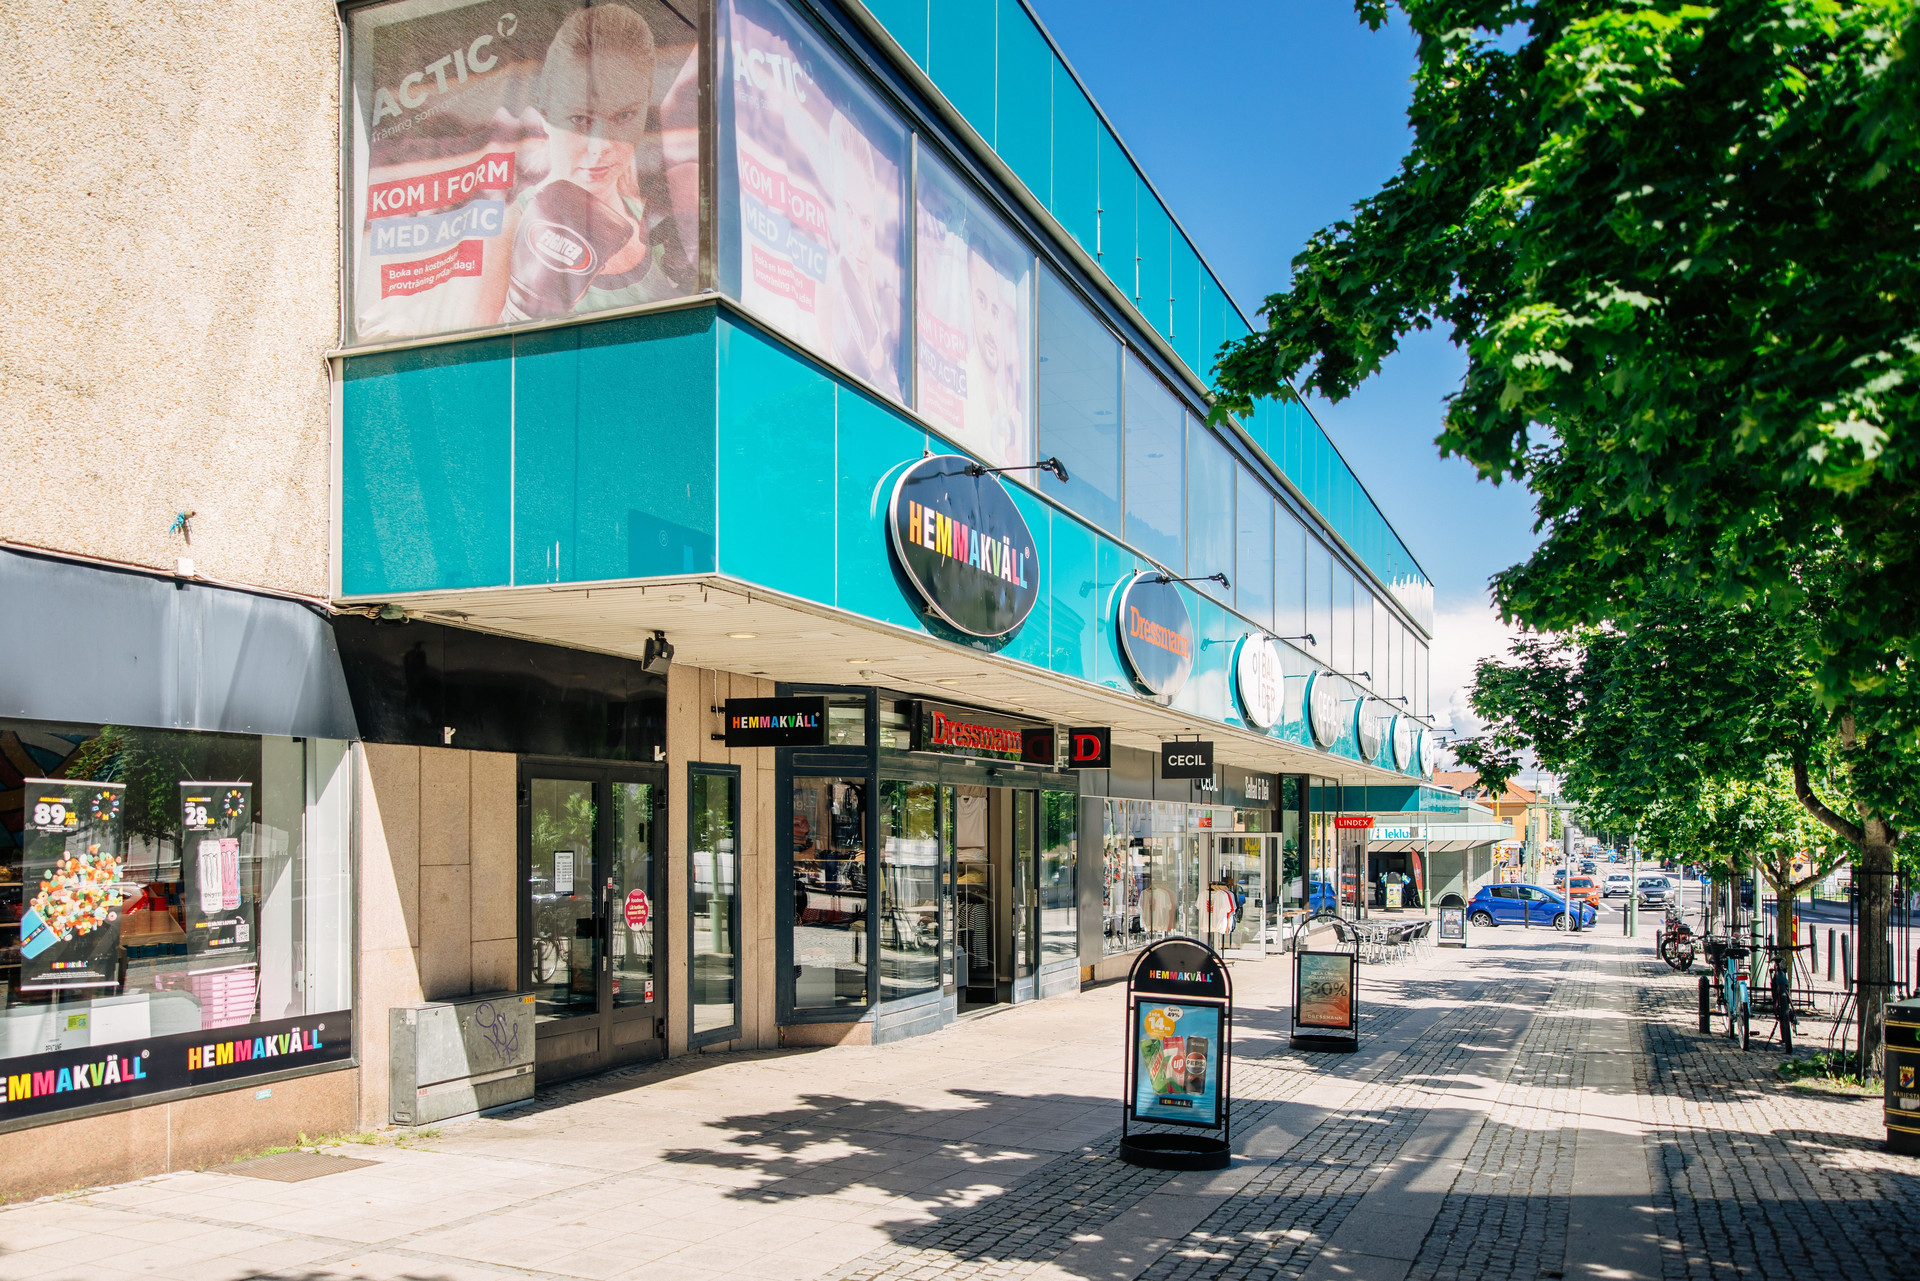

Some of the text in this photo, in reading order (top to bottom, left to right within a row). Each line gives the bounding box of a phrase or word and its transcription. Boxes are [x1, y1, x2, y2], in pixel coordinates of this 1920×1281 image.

[371, 33, 499, 127] ACTIC
[734, 41, 806, 103] ACTIC
[372, 118, 412, 143] Träning
[414, 105, 439, 123] som
[373, 160, 509, 212] KOM I FORM
[741, 157, 772, 199] KOM
[787, 190, 826, 232] ORM
[377, 207, 498, 249] MED ACTIC
[746, 202, 778, 241] MED
[389, 269, 411, 280] Boka
[413, 267, 424, 276] en
[909, 500, 1028, 589] HEMMAKVÄLL
[1130, 605, 1190, 660] Dressmann
[732, 712, 818, 729] HEMMAKVÄLL
[932, 711, 1022, 754] Dressmann
[1168, 755, 1206, 767] CECIL
[34, 803, 66, 825] 89
[185, 806, 208, 825] 28
[1339, 819, 1368, 827] LINDEX
[1385, 828, 1410, 839] leklu
[1149, 969, 1212, 982] HEMMAKVÄLL
[1148, 1016, 1164, 1031] 14
[188, 1027, 323, 1070] HEMMAKVÄLL
